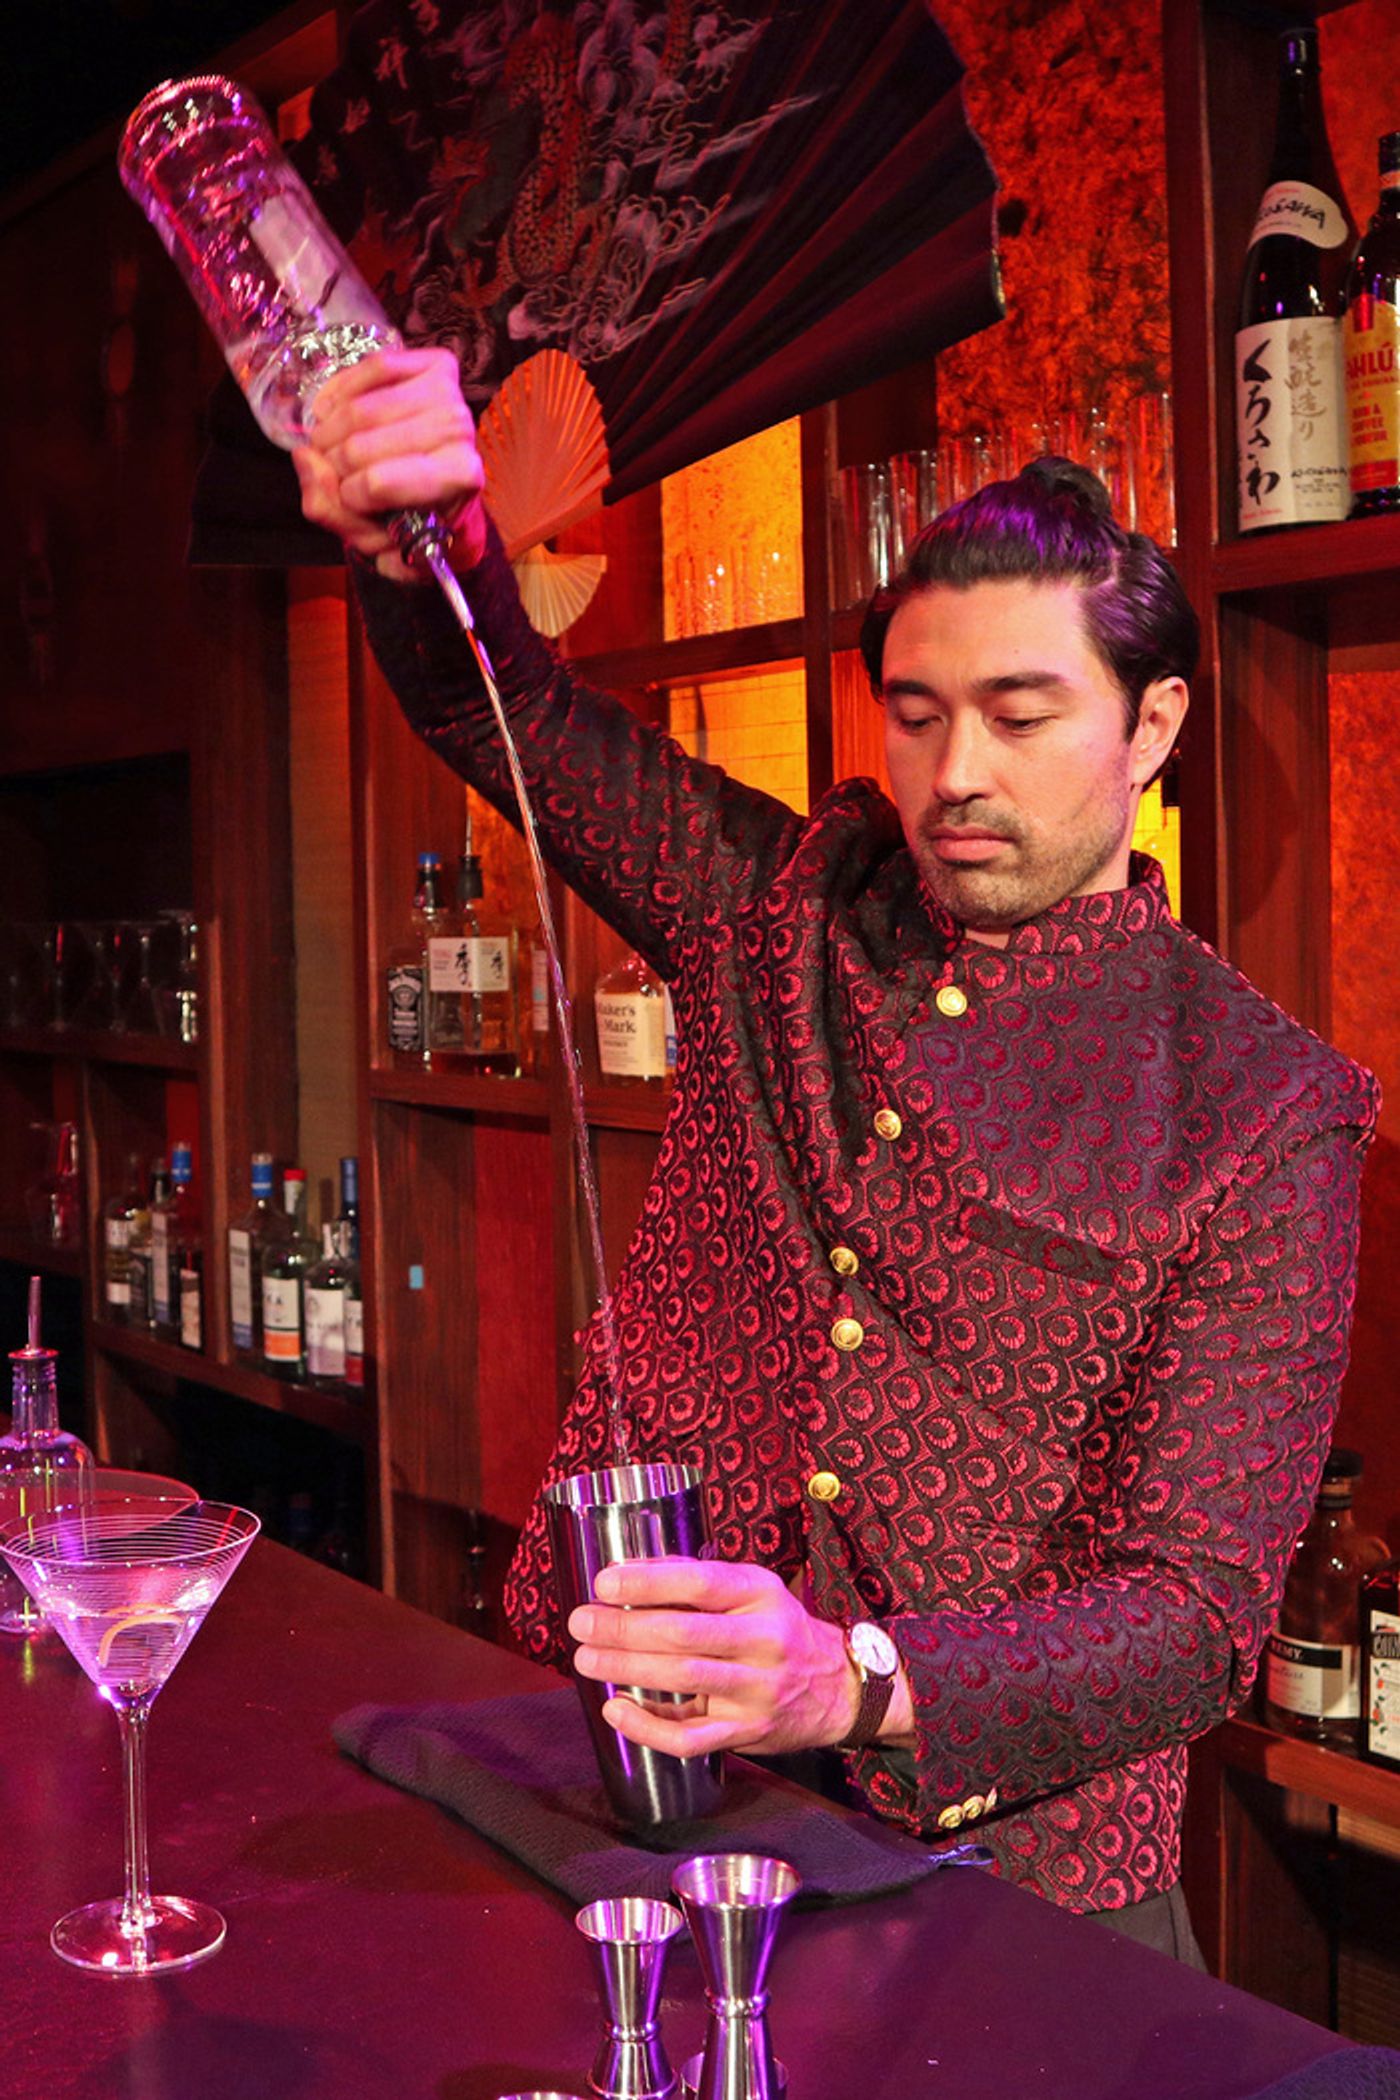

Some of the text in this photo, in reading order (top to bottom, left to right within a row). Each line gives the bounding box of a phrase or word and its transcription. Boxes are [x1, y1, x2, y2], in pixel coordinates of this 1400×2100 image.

[1243, 338, 1281, 507] くろさわ
[598, 1003, 636, 1017] aker's
